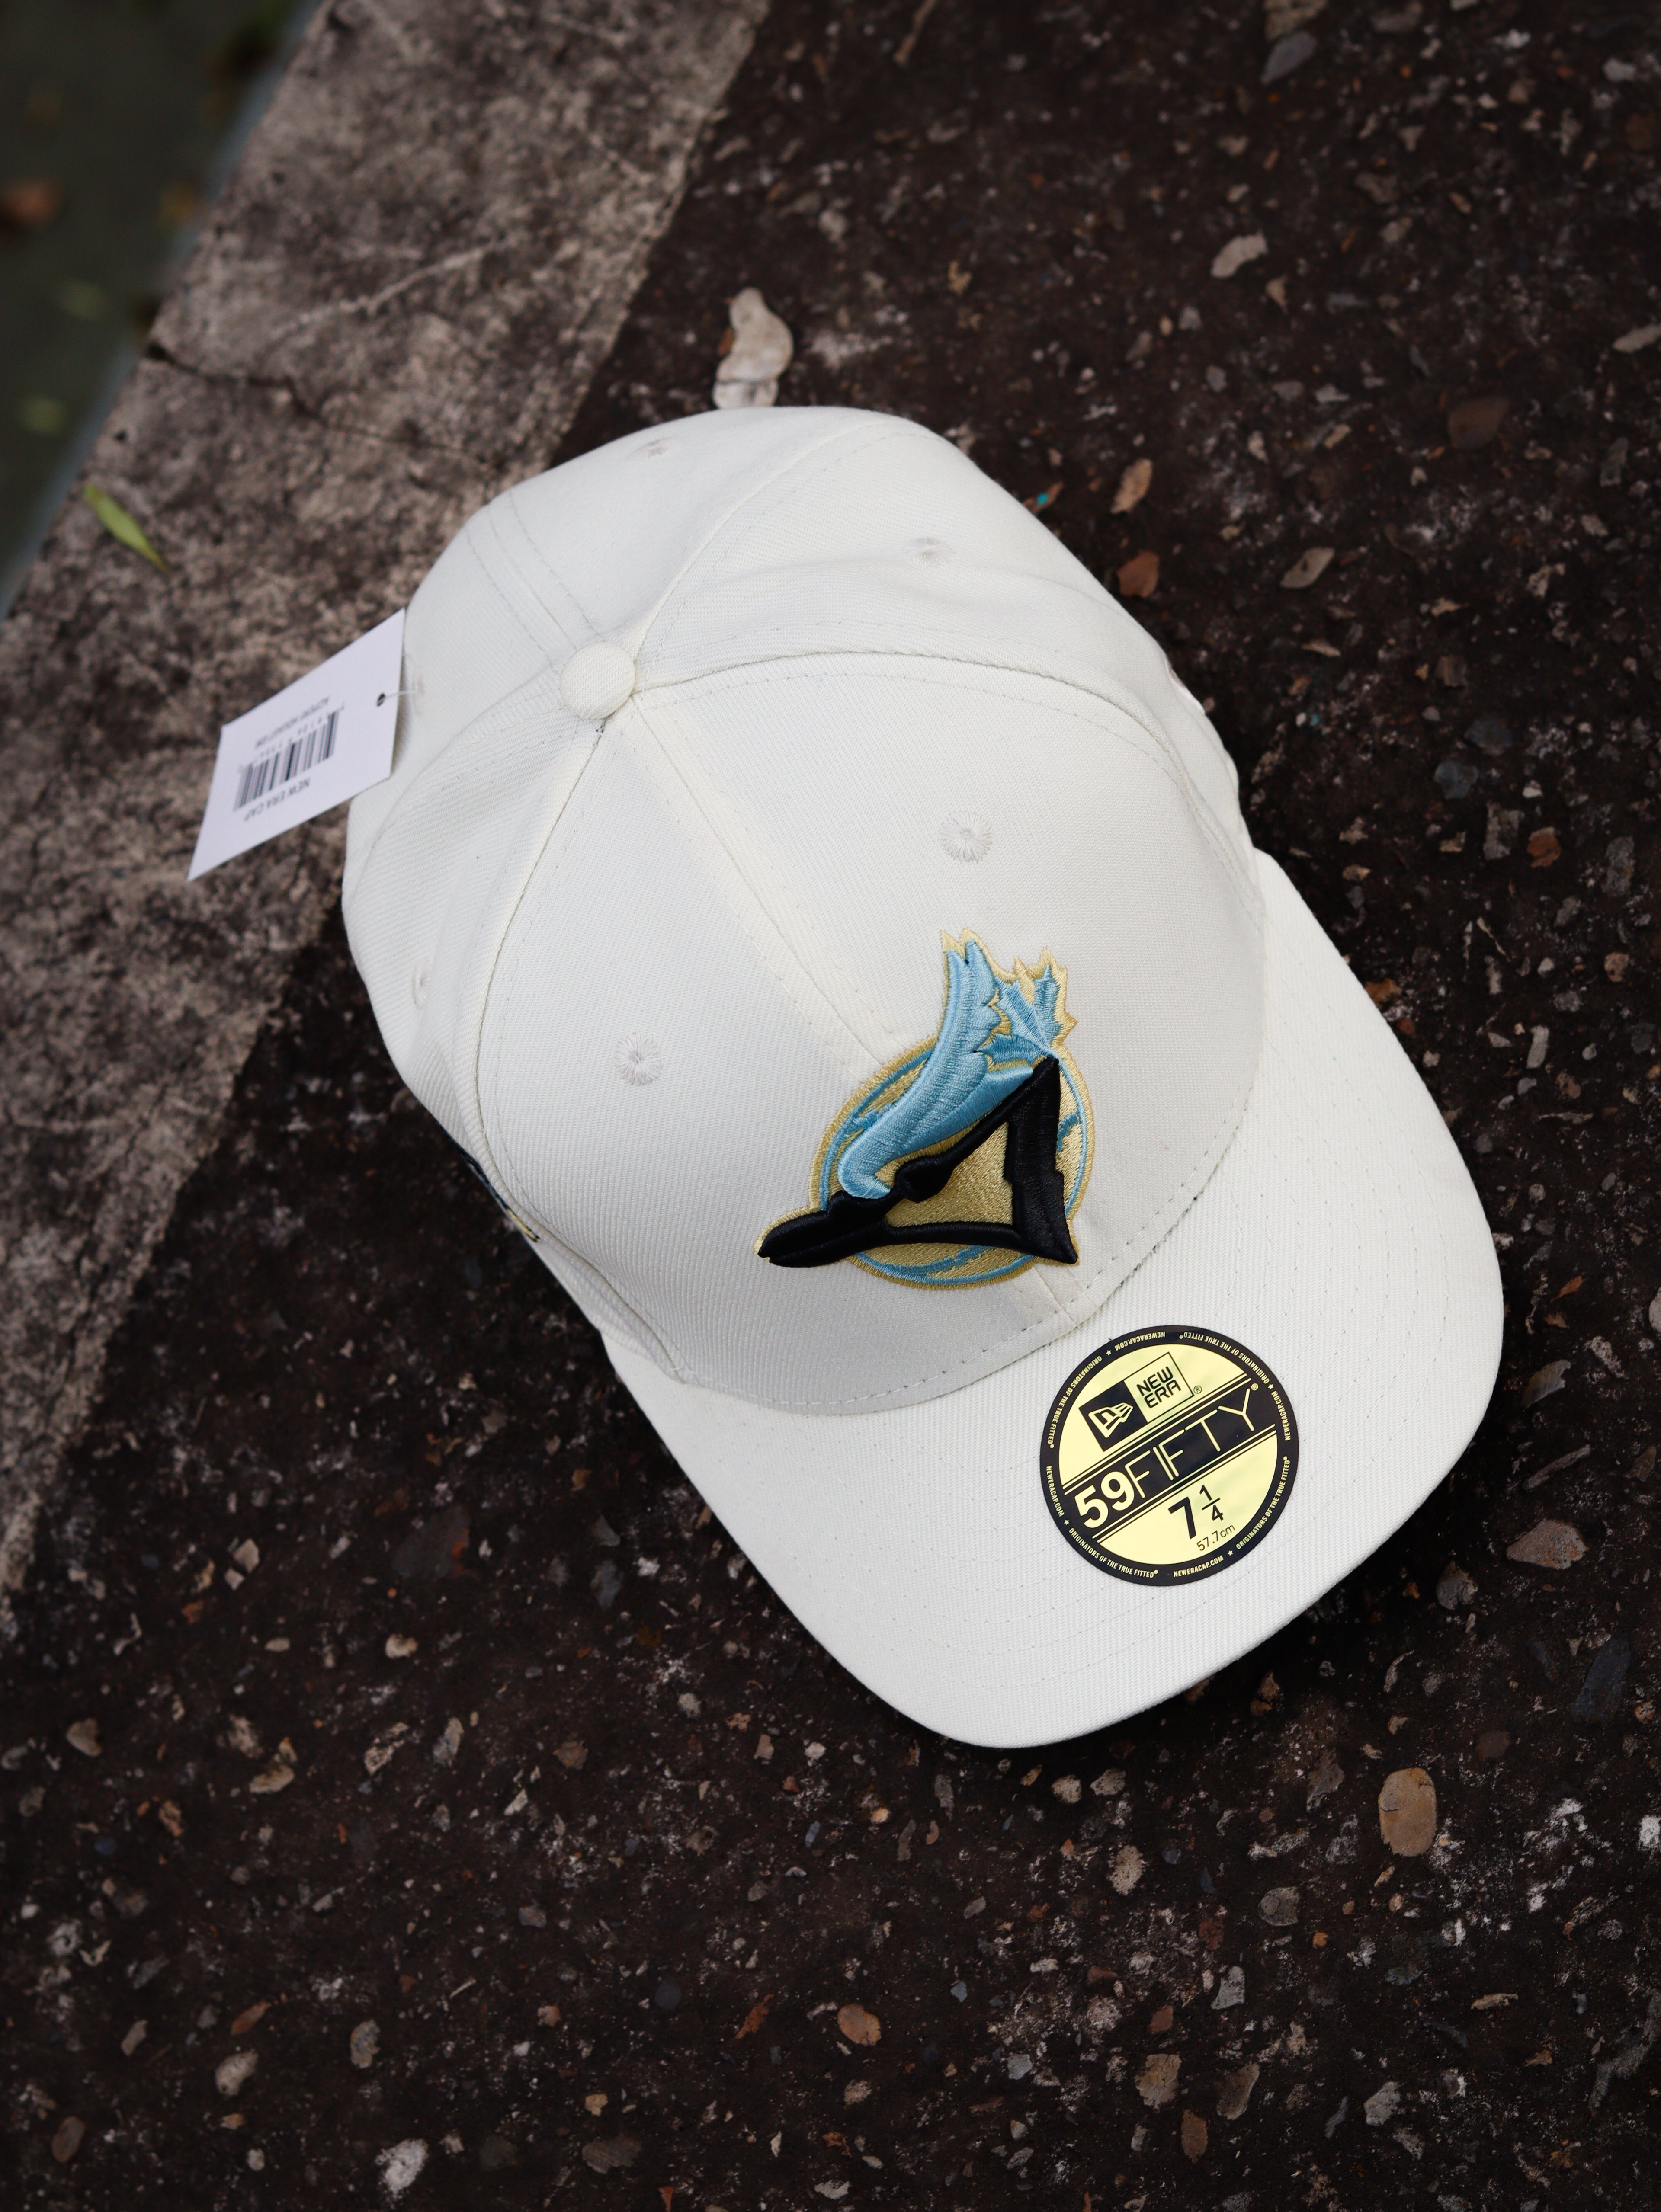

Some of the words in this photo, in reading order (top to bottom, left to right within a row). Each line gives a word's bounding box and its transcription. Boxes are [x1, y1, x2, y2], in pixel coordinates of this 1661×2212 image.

[1114, 1331, 1165, 1351] NEWERACAP.COM
[1204, 1336, 1220, 1346] TRUE
[1219, 1341, 1231, 1352] THE
[1070, 1356, 1102, 1389] ORIGINATORS
[1136, 1366, 1174, 1396] NEW
[1238, 1352, 1270, 1384] ORIGINATORS
[1058, 1396, 1069, 1409] THE
[1065, 1387, 1073, 1397] OF
[1144, 1380, 1181, 1408] ERA
[1052, 1407, 1063, 1423] TRUE
[1271, 1390, 1291, 1441] NEWERACAP.COM
[1046, 1466, 1065, 1517] NEWERACAP.COM
[1236, 1516, 1268, 1549] ORIGINATORS
[1265, 1508, 1273, 1517] OF
[1269, 1497, 1279, 1508] THE
[1275, 1481, 1286, 1496] TRUE
[1069, 1528, 1100, 1559] ORIGINATORS
[1106, 1559, 1118, 1569] THE
[1118, 1564, 1134, 1575] TRUE
[1174, 1555, 1224, 1578] NEWERACAP.COM
